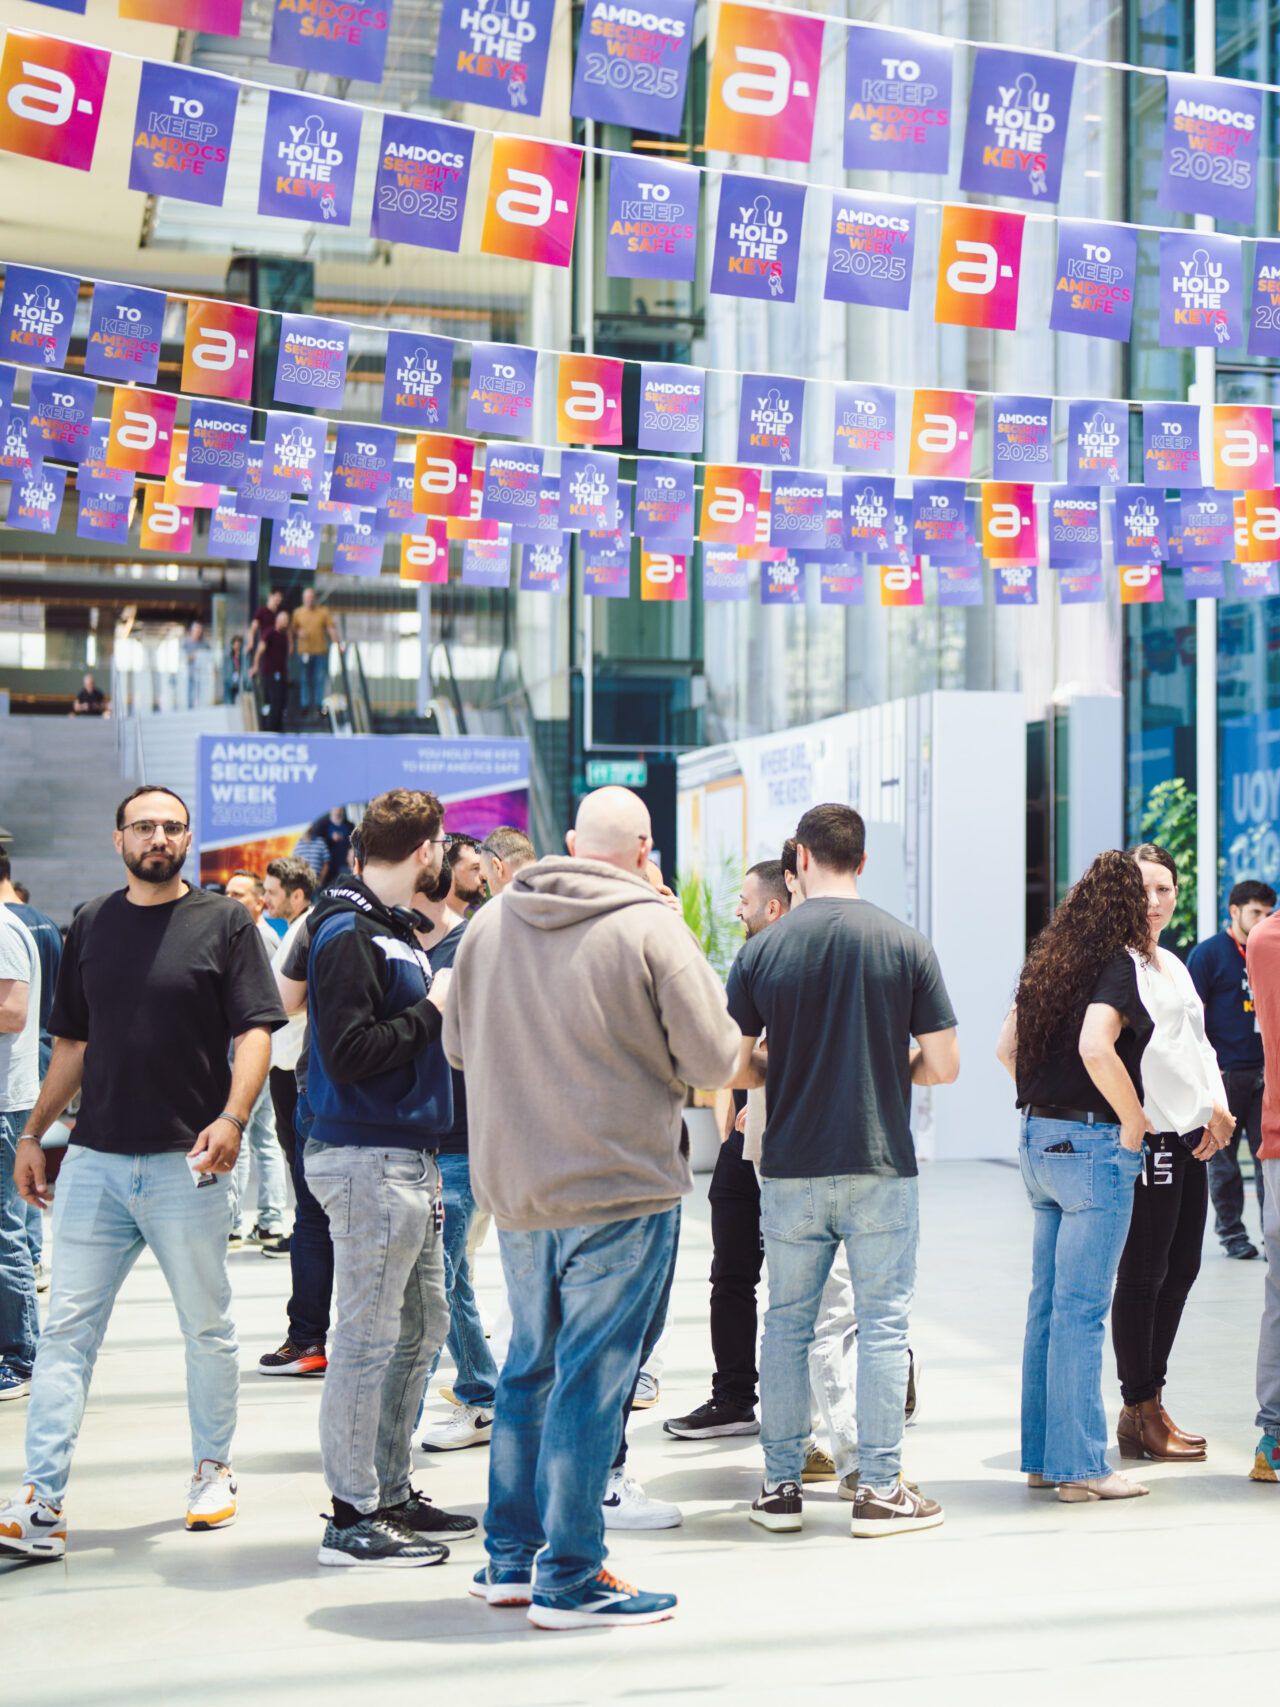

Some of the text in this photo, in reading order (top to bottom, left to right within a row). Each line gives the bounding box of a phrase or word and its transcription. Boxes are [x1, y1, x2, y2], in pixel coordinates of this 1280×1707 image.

[882, 58, 918, 80] TO
[862, 78, 934, 107] KEEP
[168, 94, 203, 118] TO
[848, 102, 945, 126] AMDOCS
[1176, 98, 1254, 131] AMDOCS
[148, 110, 216, 145] KEEP
[869, 122, 925, 142] SAFE
[1174, 115, 1252, 147] SECURITY
[134, 130, 225, 164] AMDOCS
[278, 141, 342, 166] HOLD
[386, 140, 463, 169] AMDOCS
[1188, 134, 1235, 158] WEEK
[152, 151, 203, 175] SAFE
[285, 160, 330, 182] THE
[383, 156, 460, 183] SECURITY
[1171, 145, 1251, 190] 2025
[276, 176, 336, 199] KEYS
[397, 173, 444, 193] WEEK
[378, 184, 457, 222] 2025
[1083, 244, 1110, 263] TO
[1067, 258, 1123, 286] KEEP
[1057, 276, 1132, 304] AMDOCS
[1174, 277, 1228, 293] HOLD
[1071, 293, 1114, 316] SAFE
[1181, 293, 1220, 309] THE
[1175, 308, 1226, 324] KEYS
[397, 368, 441, 385] HOLD
[402, 381, 433, 396] THE
[646, 381, 699, 395] AMDOCS
[396, 393, 438, 409] KEYS
[645, 392, 698, 405] SECURITY
[655, 402, 687, 413] WEEK
[855, 400, 875, 413] TO
[195, 418, 246, 434] AMDOCS
[644, 411, 698, 432] 2025
[843, 411, 885, 430] KEEP
[194, 428, 244, 443] SECURITY
[203, 438, 234, 450] WEEK
[836, 425, 892, 443] AMDOCS
[848, 437, 879, 451] SAFE
[191, 446, 243, 469] 2025
[851, 505, 886, 517] HOLD
[856, 516, 881, 527] THE
[852, 526, 885, 538] KEYS
[211, 743, 309, 763] AMDOCS
[211, 763, 318, 783] SECURITY
[211, 784, 277, 803] WEEK
